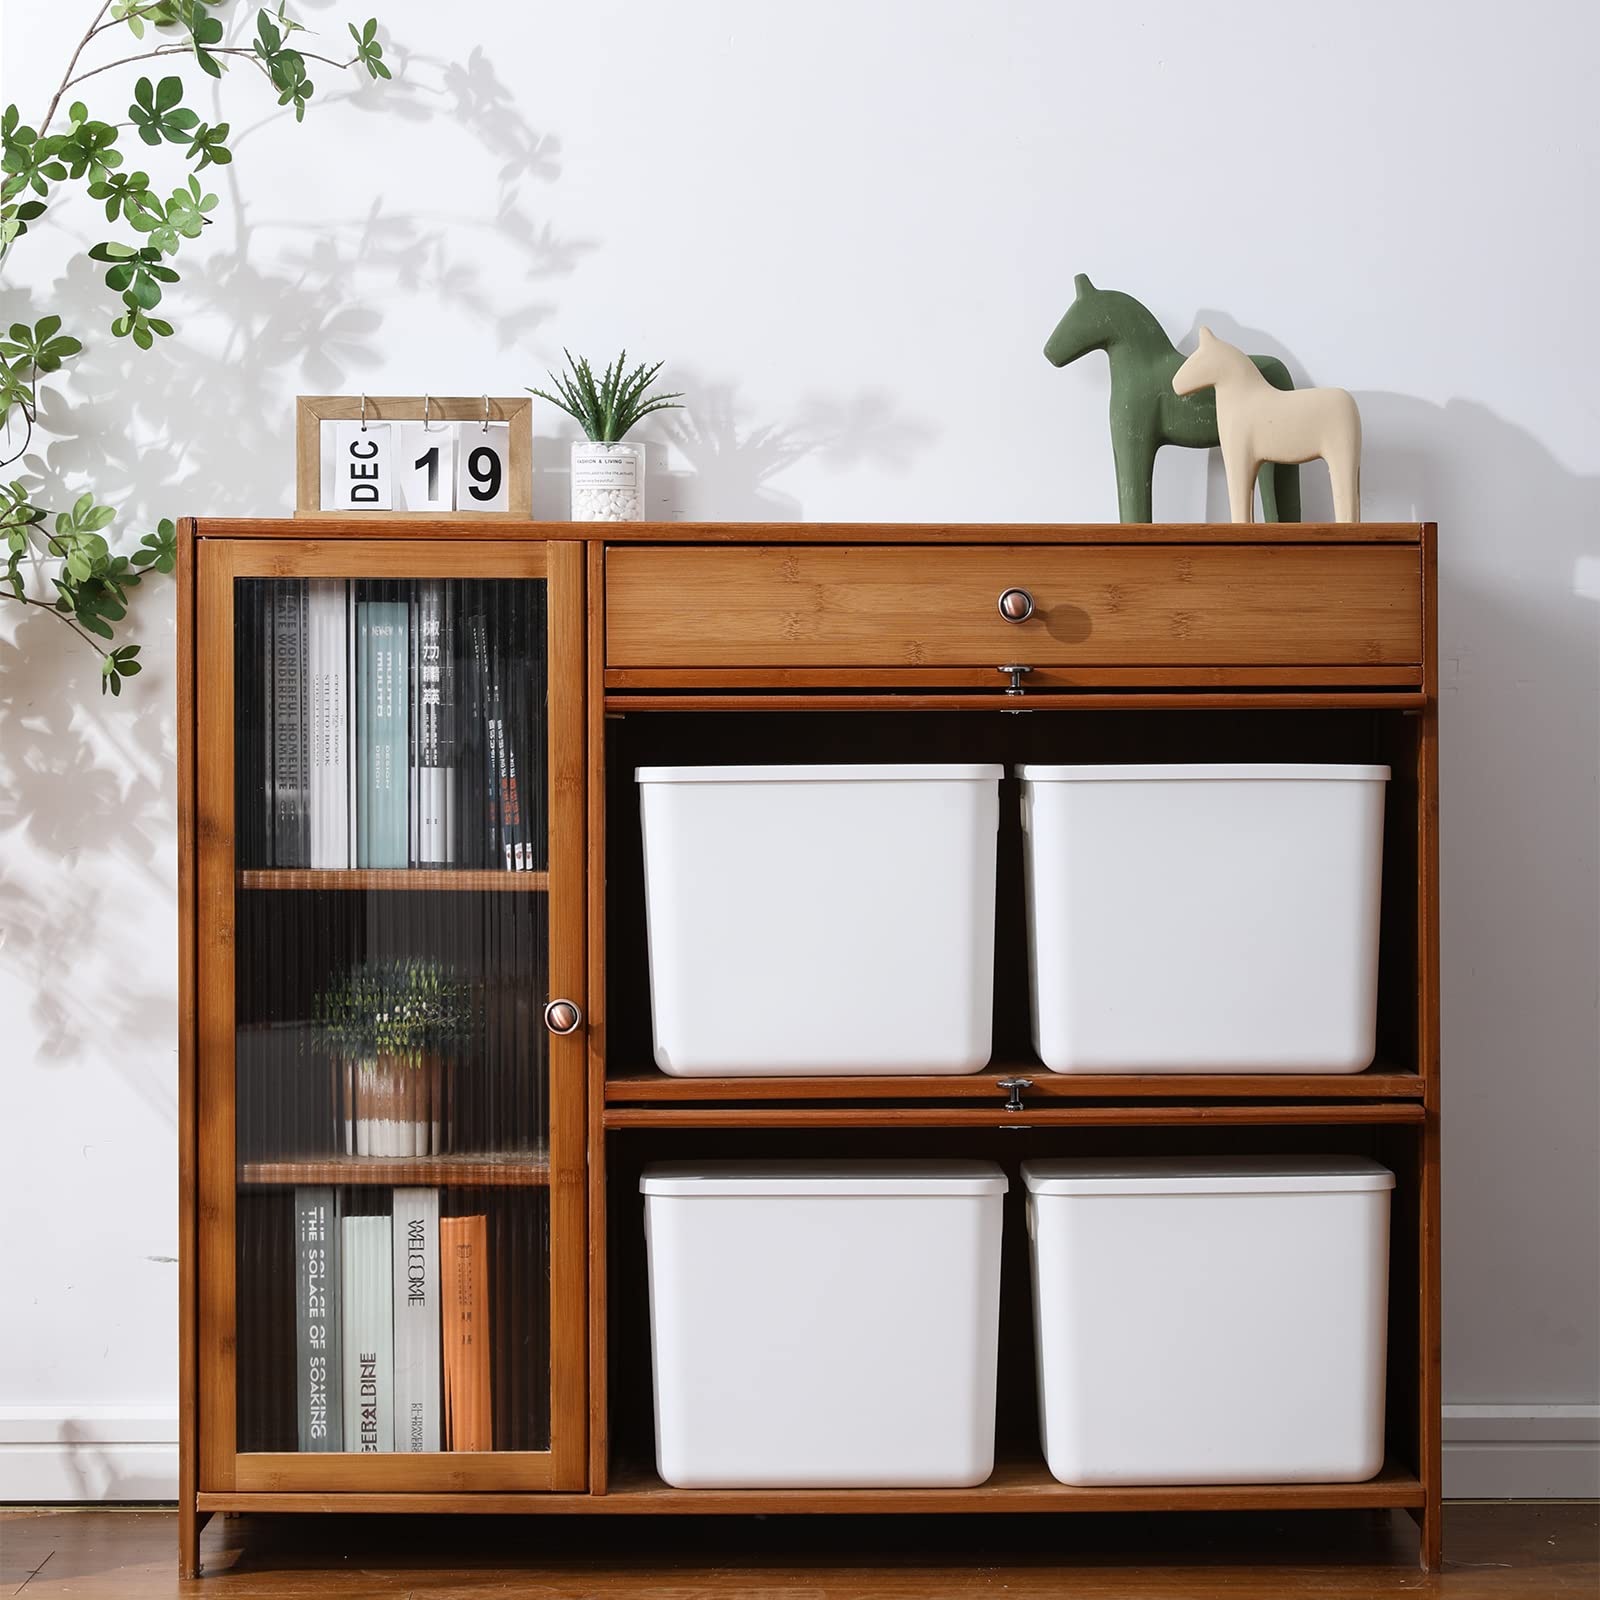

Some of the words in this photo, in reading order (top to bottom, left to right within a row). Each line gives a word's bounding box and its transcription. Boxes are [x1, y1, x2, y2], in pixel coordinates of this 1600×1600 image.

[350, 440, 379, 502] DEC
[308, 1207, 319, 1242] THE
[308, 1249, 319, 1318] SOLACE
[407, 1219, 425, 1307] WELCOME
[309, 1325, 319, 1350] OF
[309, 1356, 321, 1440] SOAKING
